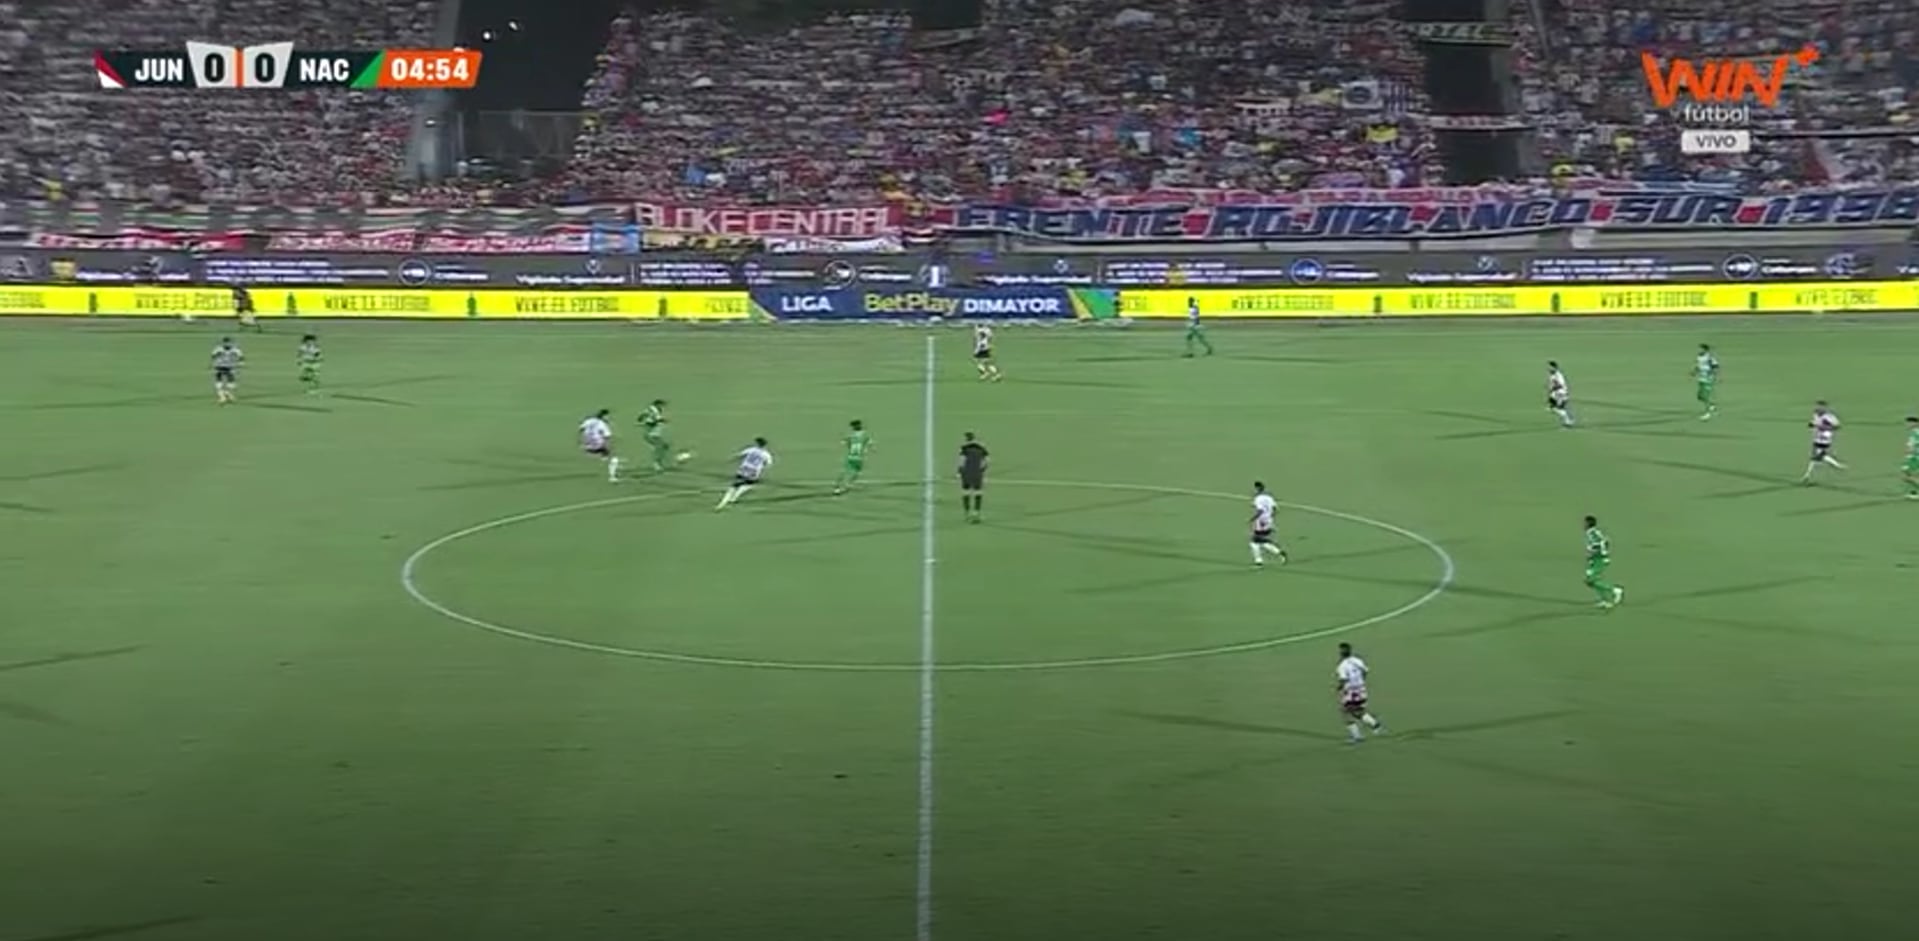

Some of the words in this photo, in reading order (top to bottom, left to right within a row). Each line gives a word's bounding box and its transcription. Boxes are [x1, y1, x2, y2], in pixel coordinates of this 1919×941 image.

[1610, 195, 1744, 224] SUR
[782, 296, 833, 312] LIGA
[863, 294, 958, 317] BetPlay
[963, 297, 1060, 313] DIMAYOR
